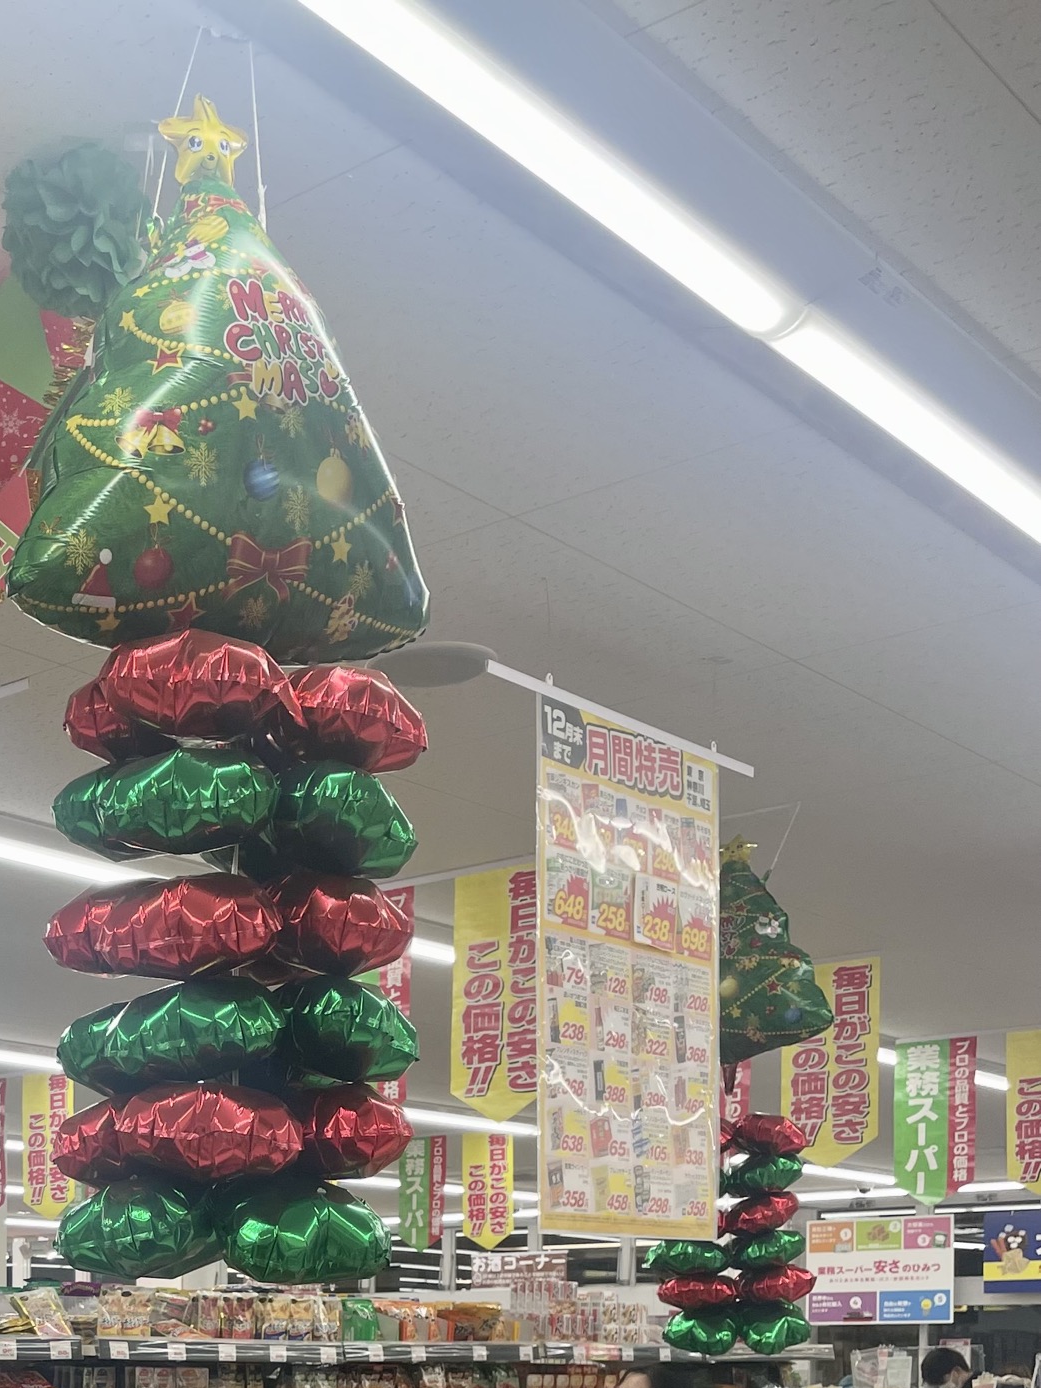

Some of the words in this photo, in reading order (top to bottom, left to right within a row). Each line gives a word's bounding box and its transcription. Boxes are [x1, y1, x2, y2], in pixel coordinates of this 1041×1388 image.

[553, 741, 572, 763] まで
[586, 724, 682, 797] 月間特売
[832, 964, 873, 1144] 毎日がこの安さ
[905, 1044, 941, 1195] 業務スーパー
[953, 1040, 969, 1182] プロの品質とプロの価格
[27, 1113, 47, 1207] この価格!!
[405, 1139, 425, 1245] 業務スーパー
[467, 1165, 486, 1238] この価格!!
[488, 1134, 508, 1235] 毎日がこの安さ
[472, 1253, 567, 1273] お酒コーナー
